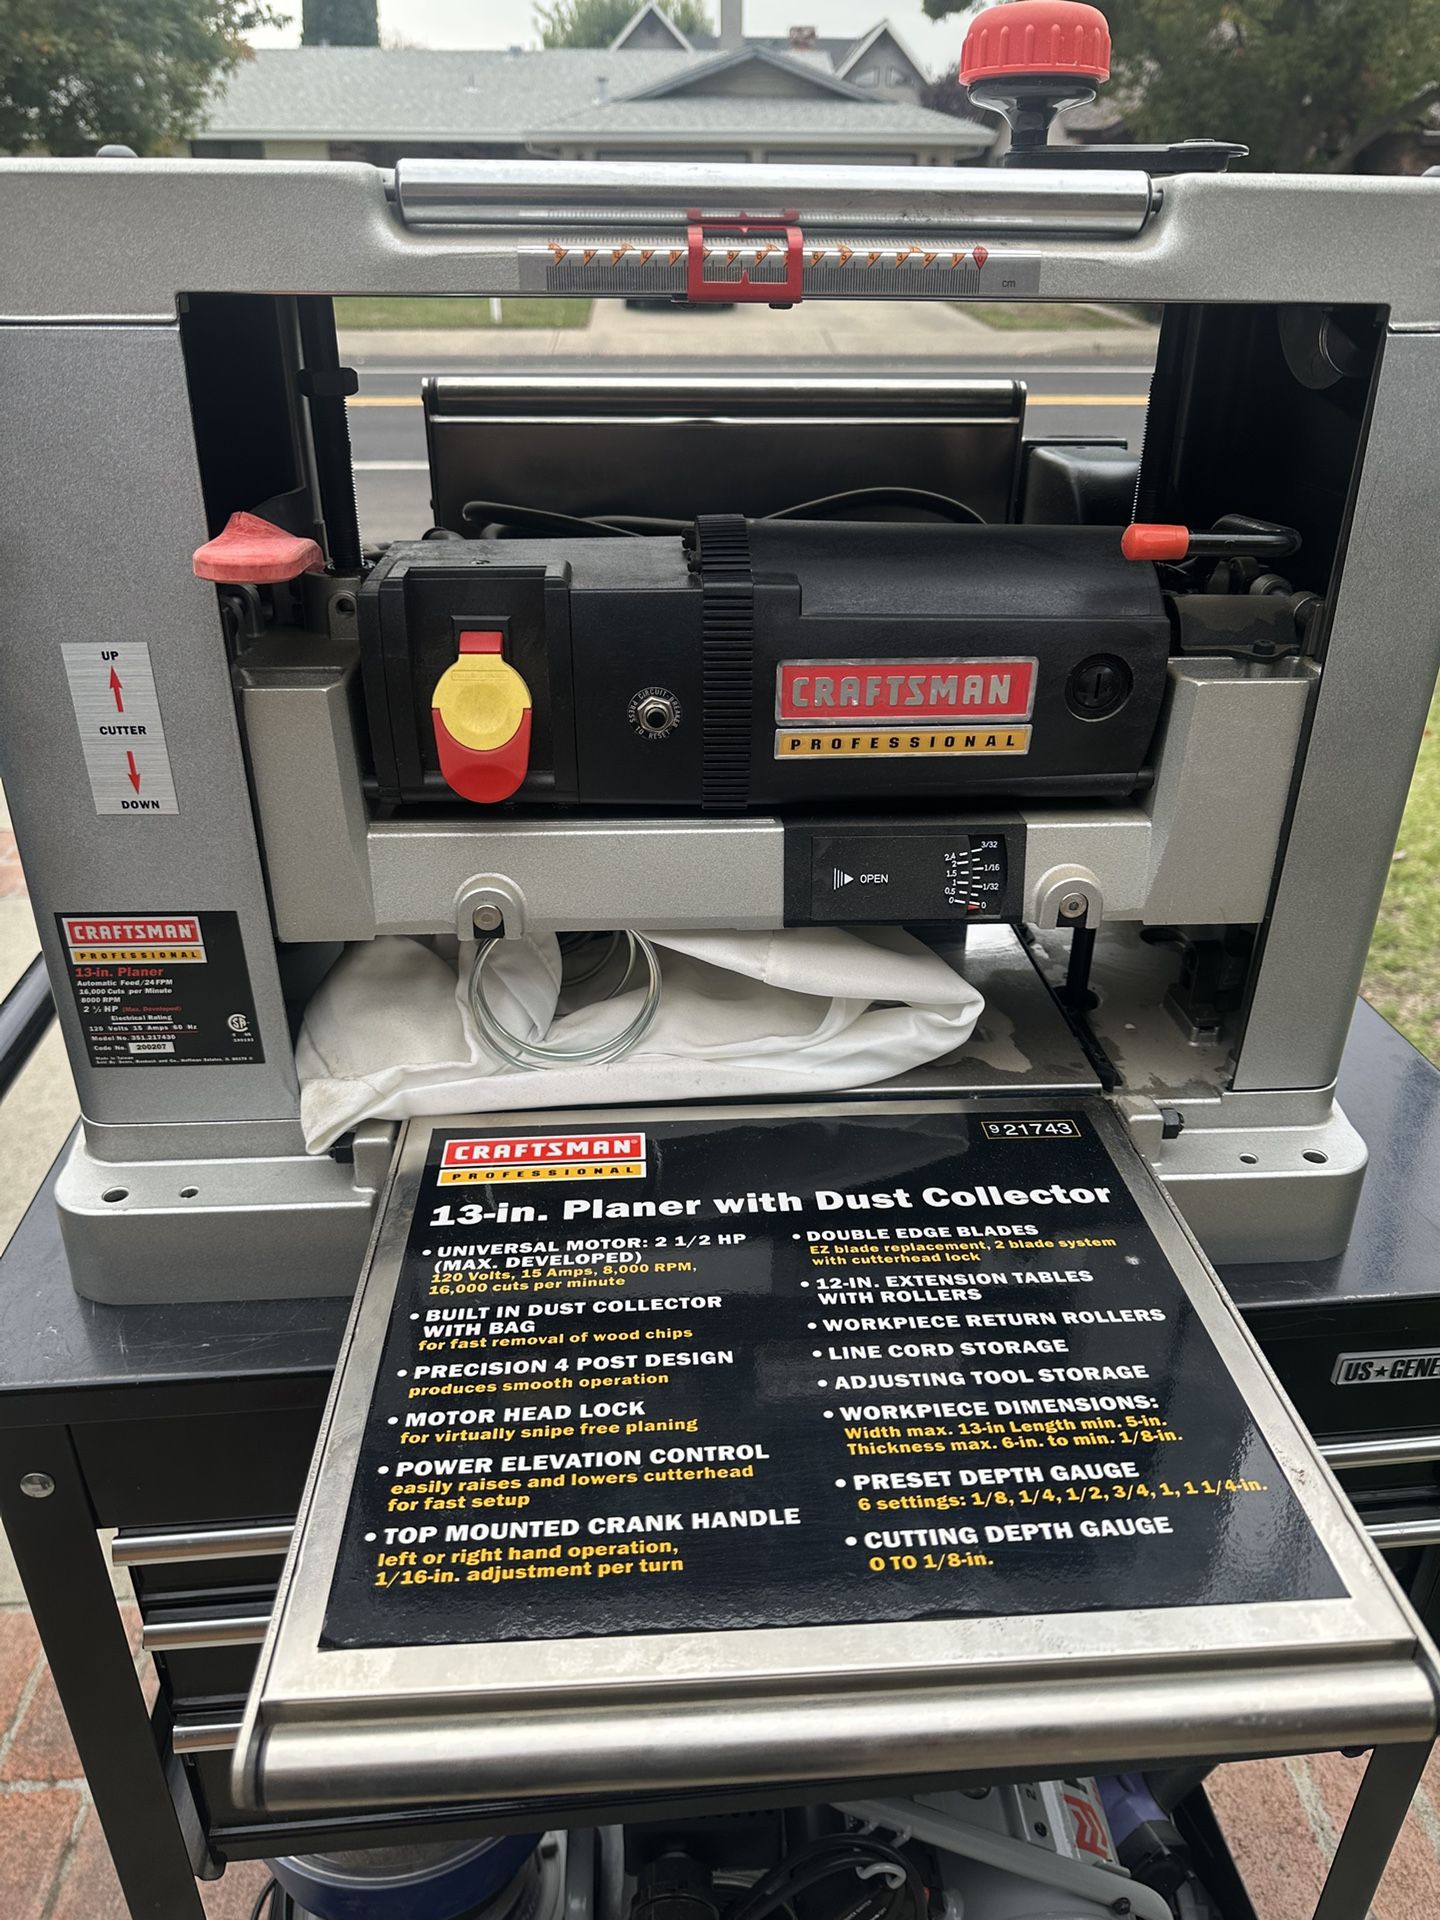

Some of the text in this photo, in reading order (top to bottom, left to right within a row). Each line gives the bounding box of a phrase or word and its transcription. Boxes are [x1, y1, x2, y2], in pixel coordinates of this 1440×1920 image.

[1002, 280, 1016, 288] cm
[101, 651, 118, 661] UP
[792, 674, 1011, 708] CRAFTSMAN
[628, 700, 670, 739] PRESS TO RESET
[99, 726, 147, 735] CUTTER
[790, 735, 1015, 751] PROFESSIONAL
[121, 800, 160, 809] DOWN
[981, 841, 998, 849] 3/32
[944, 852, 956, 861] 2.4
[947, 870, 957, 878] 1.5
[984, 863, 1000, 872] 1/16
[860, 874, 889, 884] OPEN
[983, 883, 999, 891] 1/32
[945, 887, 956, 895] 0.5
[73, 925, 191, 940] CRAFTSMAN
[80, 952, 197, 960] PROFESSIONAL
[75, 967, 164, 977] 13-in. Planer
[104, 1005, 118, 1013] HP
[454, 1139, 632, 1160] CRAFTSMAN
[452, 1166, 633, 1180] PROFESSIONAL
[430, 1185, 1110, 1226] 13-in. Planer with Dust Collector
[807, 1225, 1038, 1241] DOUBLE EDGE BLADES
[438, 1234, 746, 1257] UNIVERSAL MOTOR: 2 1/2 HP
[810, 1238, 1116, 1254] EZ blade replacement, 2 blade system
[434, 1252, 641, 1274] (MAX. DEVELOPED)
[812, 1252, 980, 1265] with cutterhead lock
[431, 1262, 696, 1282] 120 Volts, 15 Amps, 8,000 RPM,
[816, 1271, 1093, 1289] 12-IN. EXTENSION TABLES
[818, 1289, 982, 1304] WITH ROLLERS
[426, 1296, 722, 1322] BUILT IN DUST COLLECTOR
[424, 1321, 534, 1338] WITH BAG
[823, 1309, 1166, 1331] WORKPIECE RETURN ROLLERS
[419, 1328, 692, 1350] for fast removal of wood chips
[829, 1340, 1068, 1360] LINE CORD STORAGE
[414, 1351, 733, 1379] PRECISION 4 POST DESIGN
[408, 1374, 668, 1398] produces smooth operation
[835, 1365, 1149, 1389] ADJUSTING TOOL STORAGE
[405, 1401, 645, 1427] MOTOR HEAD LOCK
[840, 1395, 1158, 1420] WORKPIECE DIMENSIONS:
[401, 1419, 698, 1444] for virtually snipe free planing
[844, 1426, 901, 1439] Width
[907, 1427, 952, 1436] max.
[1010, 1419, 1076, 1433] Length
[1081, 1417, 1122, 1429] min.
[1125, 1415, 1167, 1427] 5-in.
[396, 1444, 769, 1476] POWER ELEVATION CONTROL
[391, 1465, 753, 1495] easily raises and lowers cutterhead
[854, 1462, 1139, 1490] PRESET DEPTH GAUGE
[388, 1494, 530, 1511] for fast setup
[384, 1508, 800, 1544] TOP MOUNTED CRANK HANDLE
[864, 1517, 1173, 1548] CUTTING DEPTH GAUGE
[378, 1540, 678, 1566] left or right hand operation,
[870, 1552, 993, 1570] 0 TO 1/8-in.
[375, 1559, 683, 1588] 1/16-in. adjustment per turn
